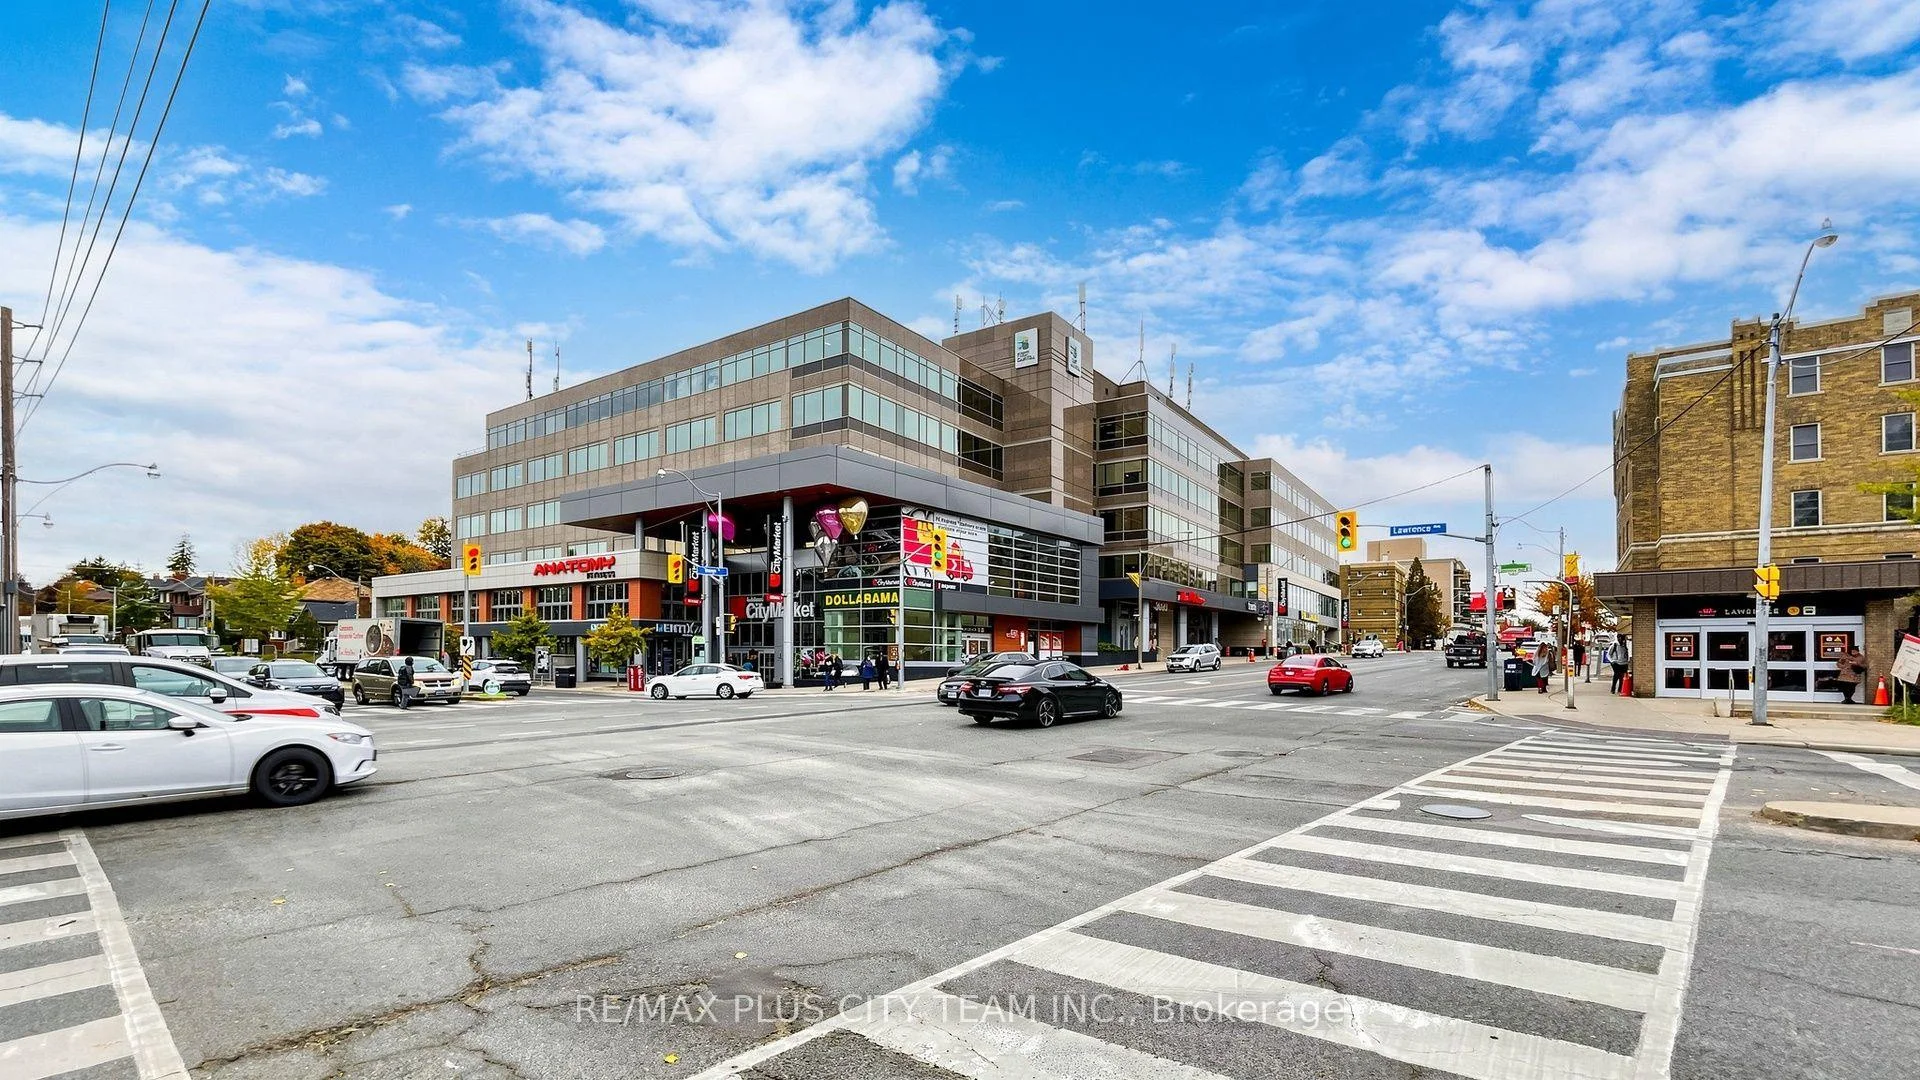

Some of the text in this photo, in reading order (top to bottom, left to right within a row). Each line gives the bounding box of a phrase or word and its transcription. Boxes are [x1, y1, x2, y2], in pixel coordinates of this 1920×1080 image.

[691, 531, 700, 580] CitMarket
[772, 522, 783, 574] CityMarket
[533, 556, 616, 576] ANATOMY
[825, 592, 899, 606] DOLLARAMA
[745, 601, 815, 623] CityMket
